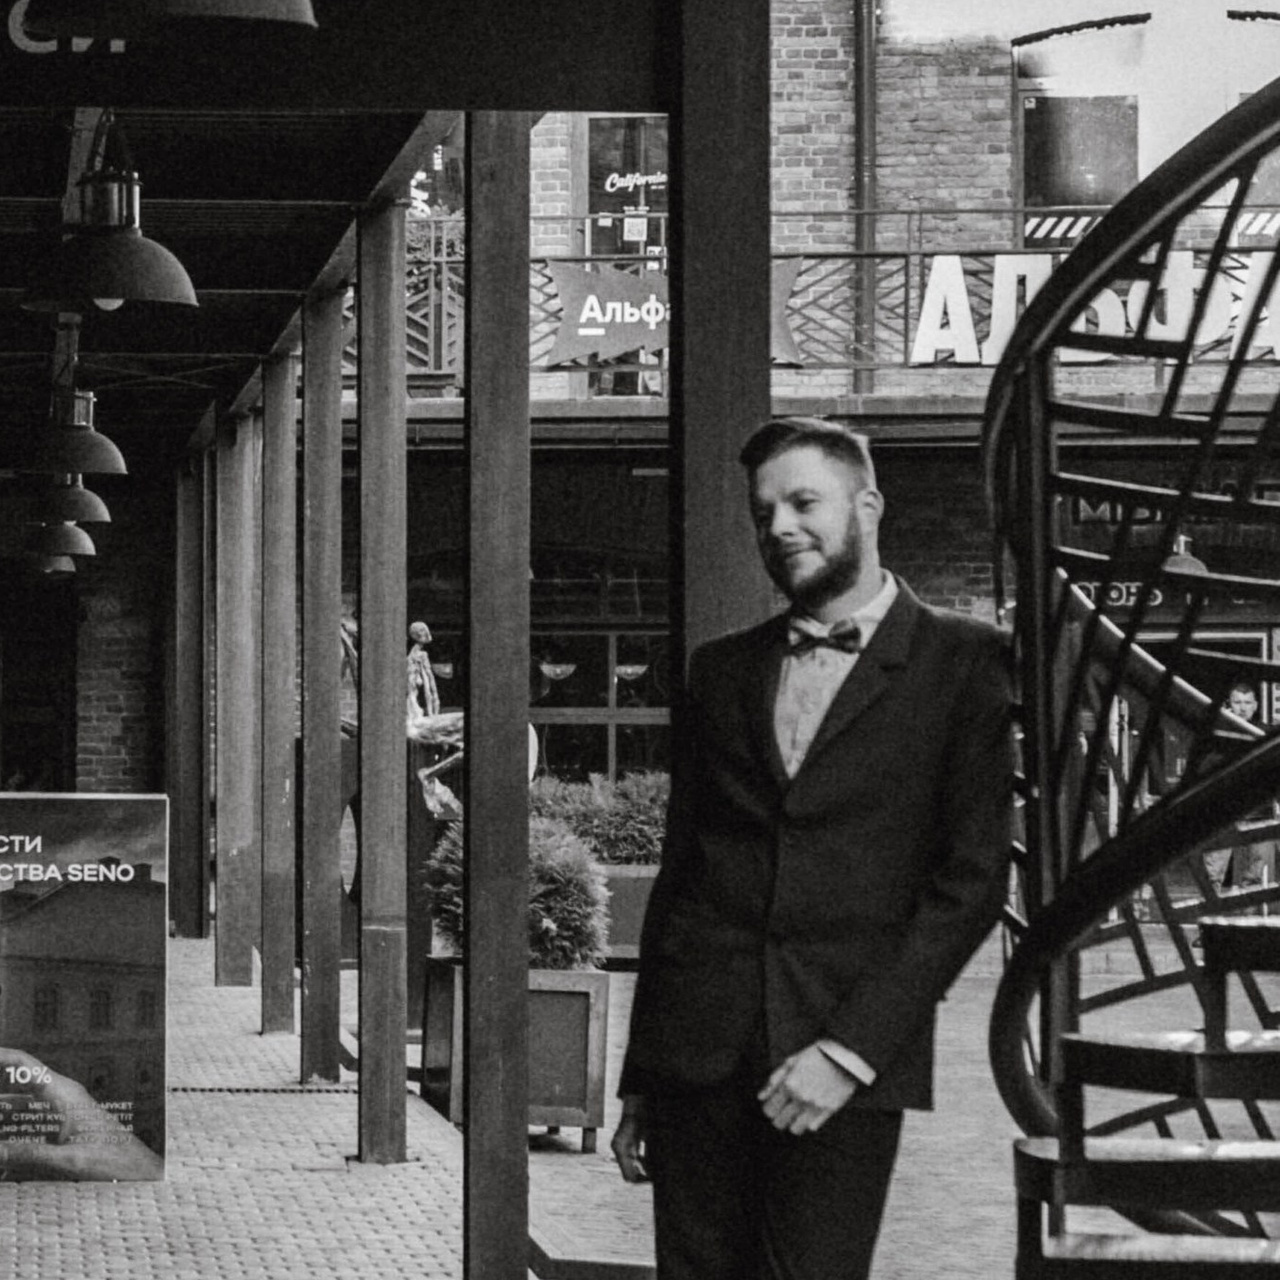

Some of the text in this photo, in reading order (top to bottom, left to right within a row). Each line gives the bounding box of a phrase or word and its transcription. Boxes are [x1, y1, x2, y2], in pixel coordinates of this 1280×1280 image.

[578, 293, 669, 330] Альф
[67, 863, 136, 883] SENO
[5, 1065, 52, 1085] 10%
